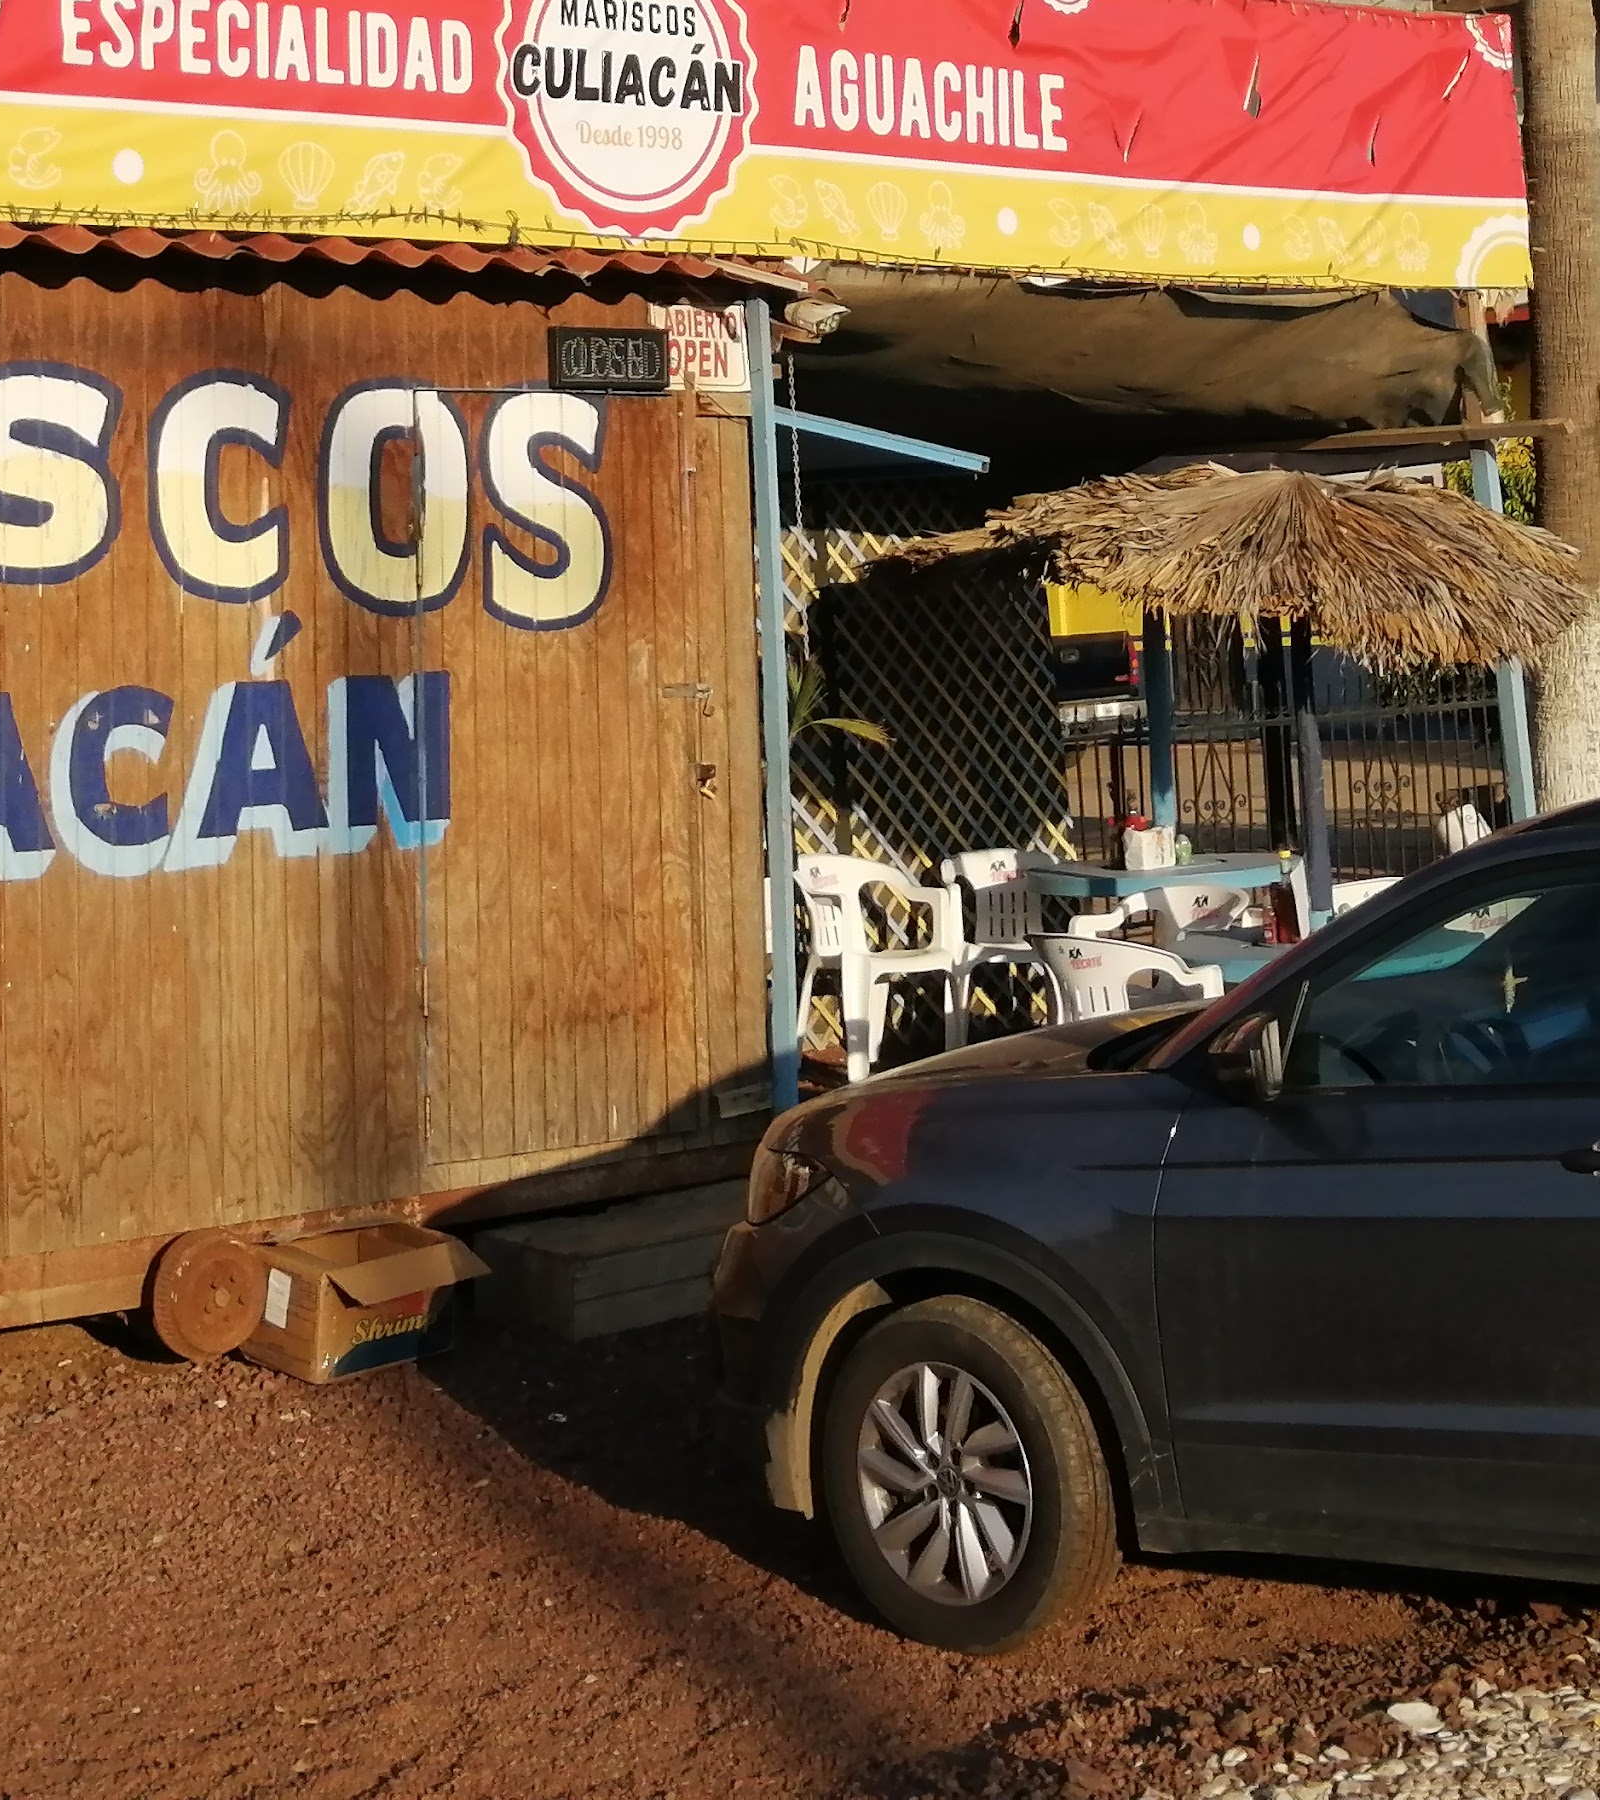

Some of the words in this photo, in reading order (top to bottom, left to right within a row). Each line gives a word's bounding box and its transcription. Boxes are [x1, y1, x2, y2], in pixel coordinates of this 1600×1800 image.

[512, 42, 742, 114] CULIACÁN
[794, 44, 1068, 152] AGUACHILE
[576, 120, 632, 148] Desde
[637, 125, 683, 151] 1998
[664, 308, 738, 341] ABIERTO
[668, 339, 729, 379] OPEN
